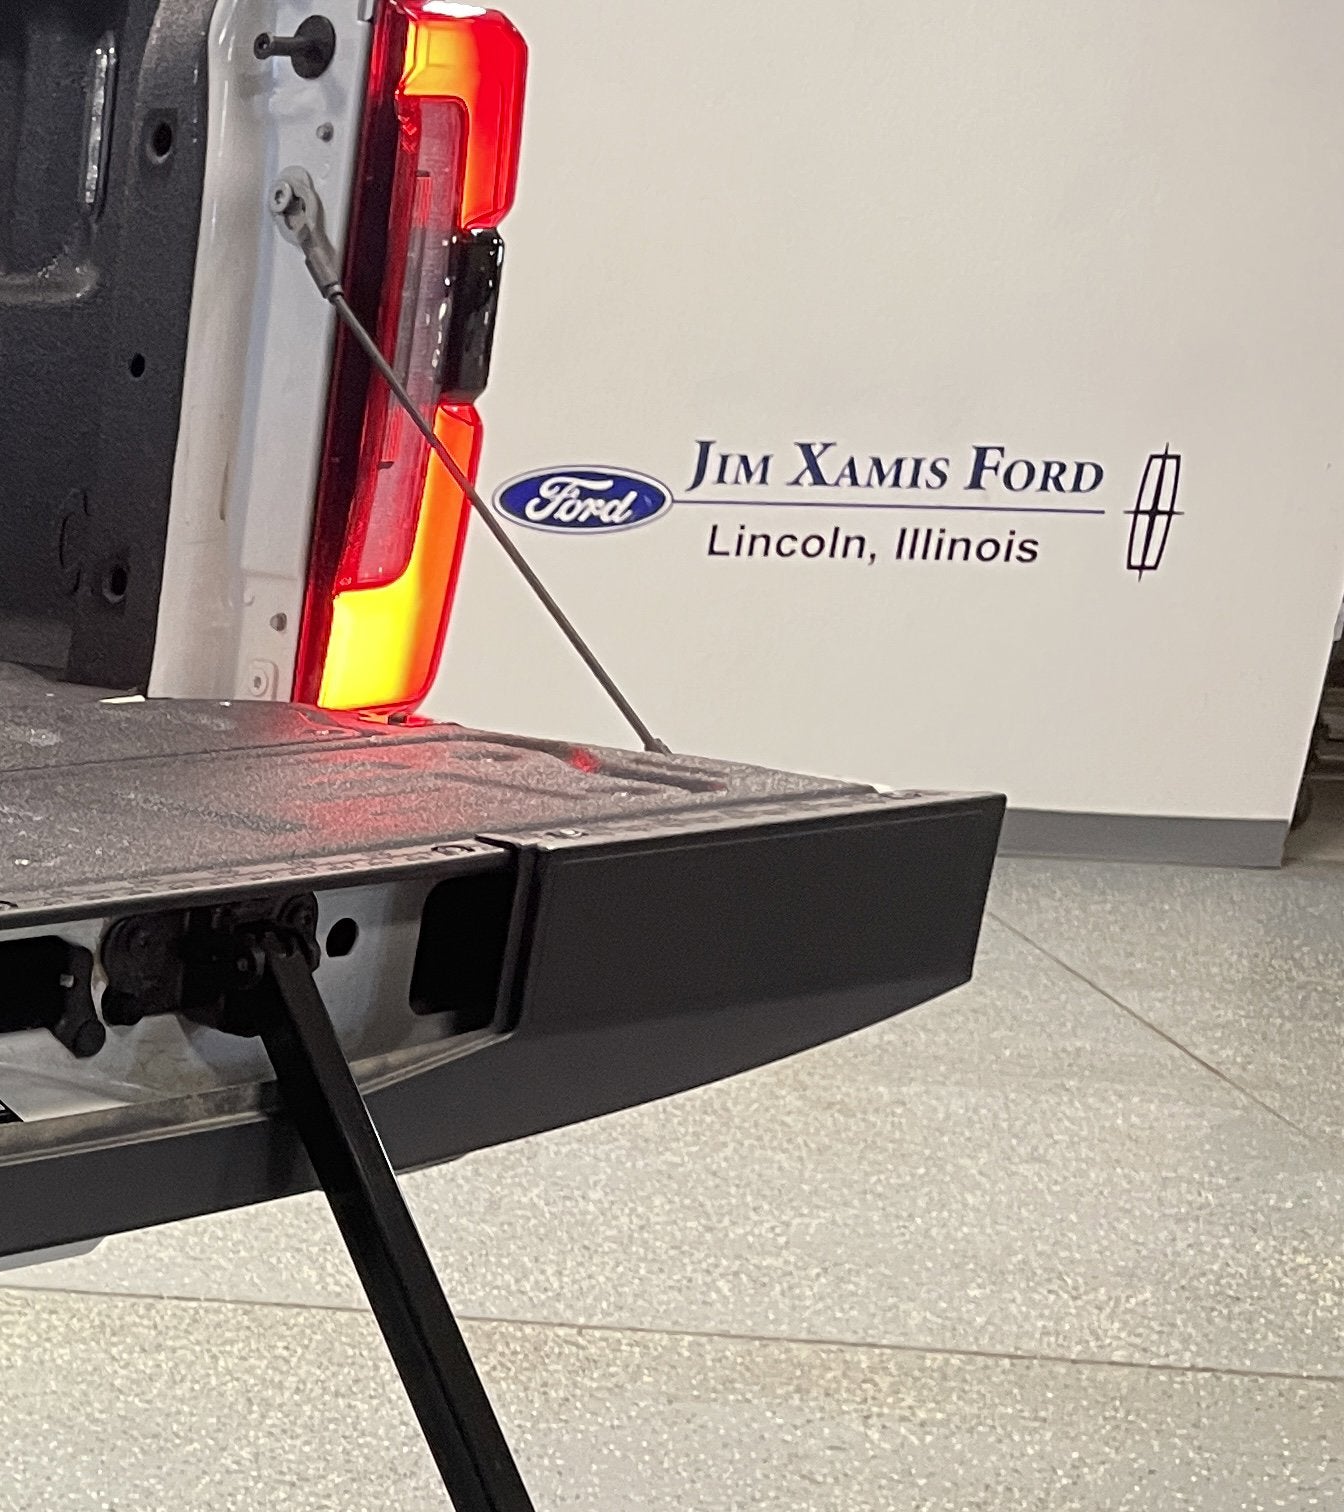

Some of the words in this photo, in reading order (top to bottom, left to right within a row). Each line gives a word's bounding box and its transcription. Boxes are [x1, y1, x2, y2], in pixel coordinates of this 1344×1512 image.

[685, 440, 772, 492] JIM
[786, 441, 950, 491] XAMIS
[964, 445, 1104, 494] FORD
[525, 476, 638, 523] Ford
[707, 524, 877, 565] Lincoln,
[895, 527, 1039, 564] Illinois
